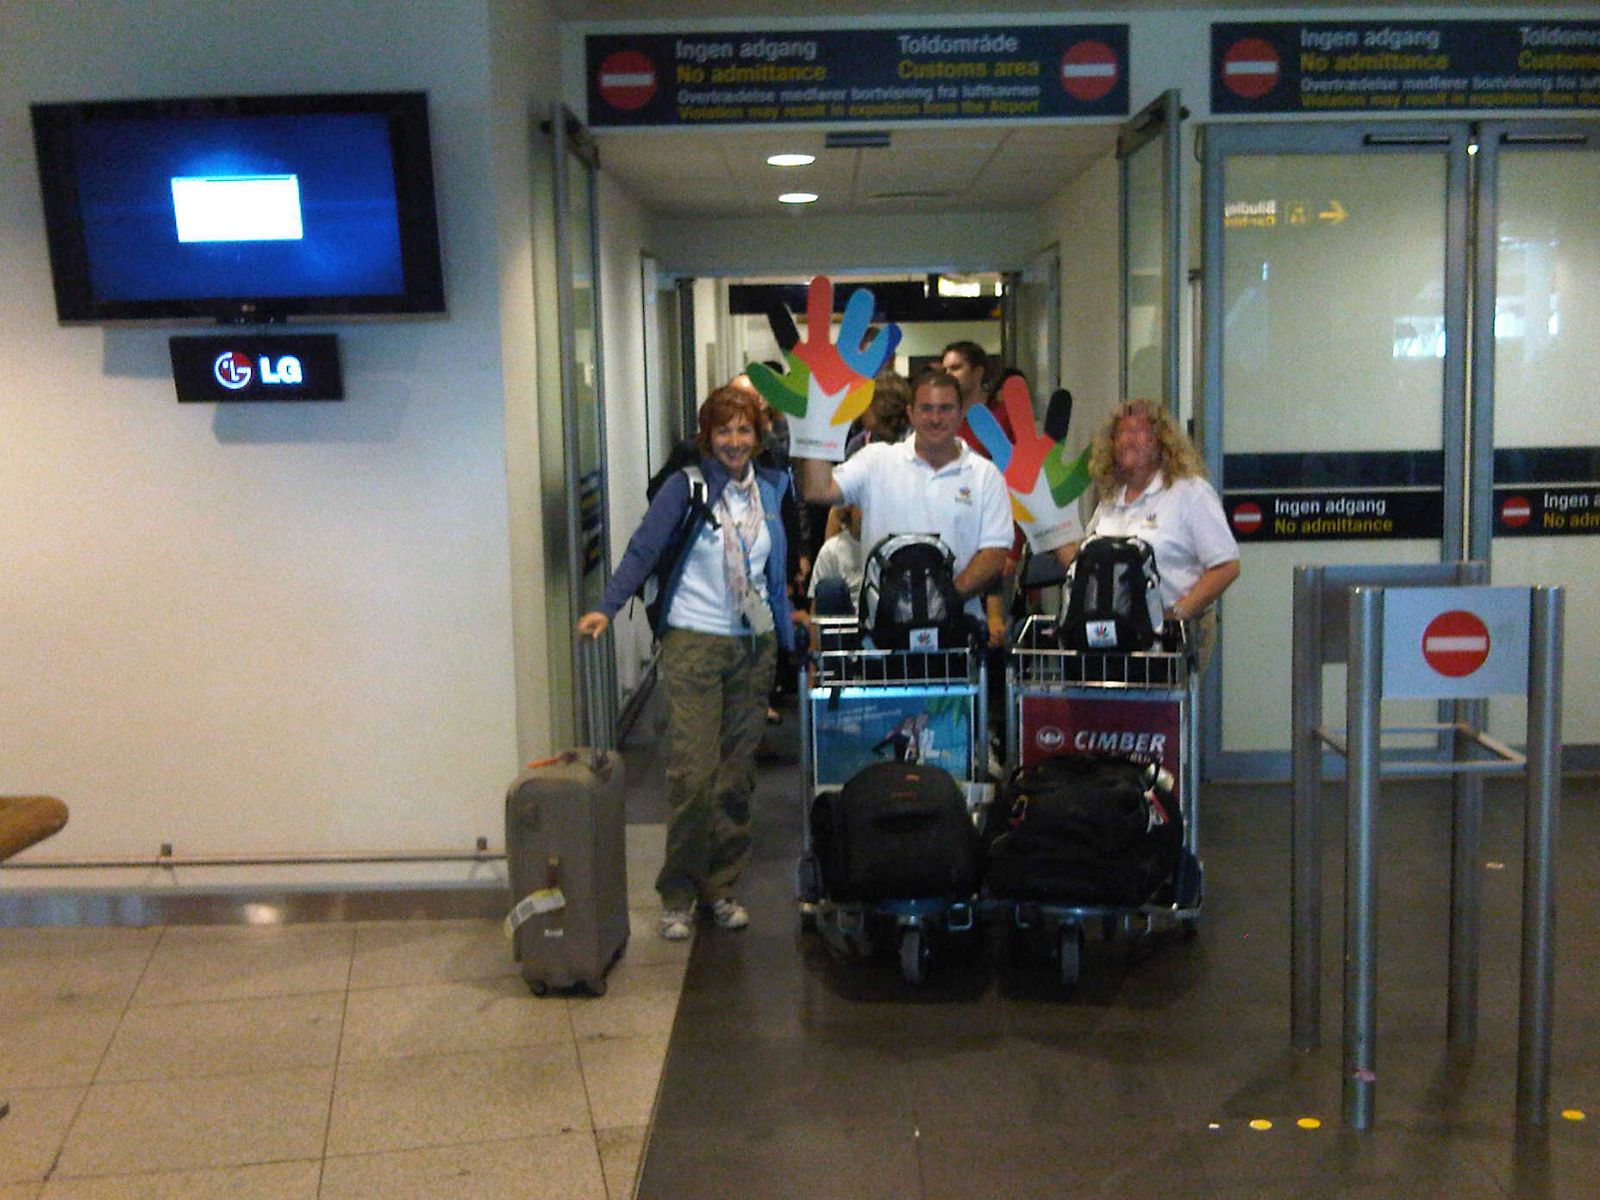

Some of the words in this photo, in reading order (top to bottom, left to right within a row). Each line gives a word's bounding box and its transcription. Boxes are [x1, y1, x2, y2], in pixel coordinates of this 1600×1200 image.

[1300, 27, 1360, 51] Ingen
[1363, 26, 1441, 50] adgang
[675, 38, 734, 62] Ingen
[739, 37, 818, 61] adgang
[898, 58, 988, 79] Customs
[994, 60, 1041, 77] area
[1300, 52, 1330, 72] No
[1334, 51, 1449, 71] admittance
[676, 64, 706, 84] No
[711, 63, 827, 84] admittance
[260, 355, 303, 384] LG
[1275, 498, 1320, 517] Ingen
[1325, 498, 1386, 516] adgang
[1544, 492, 1589, 511] Ingen
[1274, 518, 1297, 534] No
[1301, 517, 1393, 534] admittance
[1543, 512, 1565, 528] No
[1074, 730, 1166, 752] CIMBER
